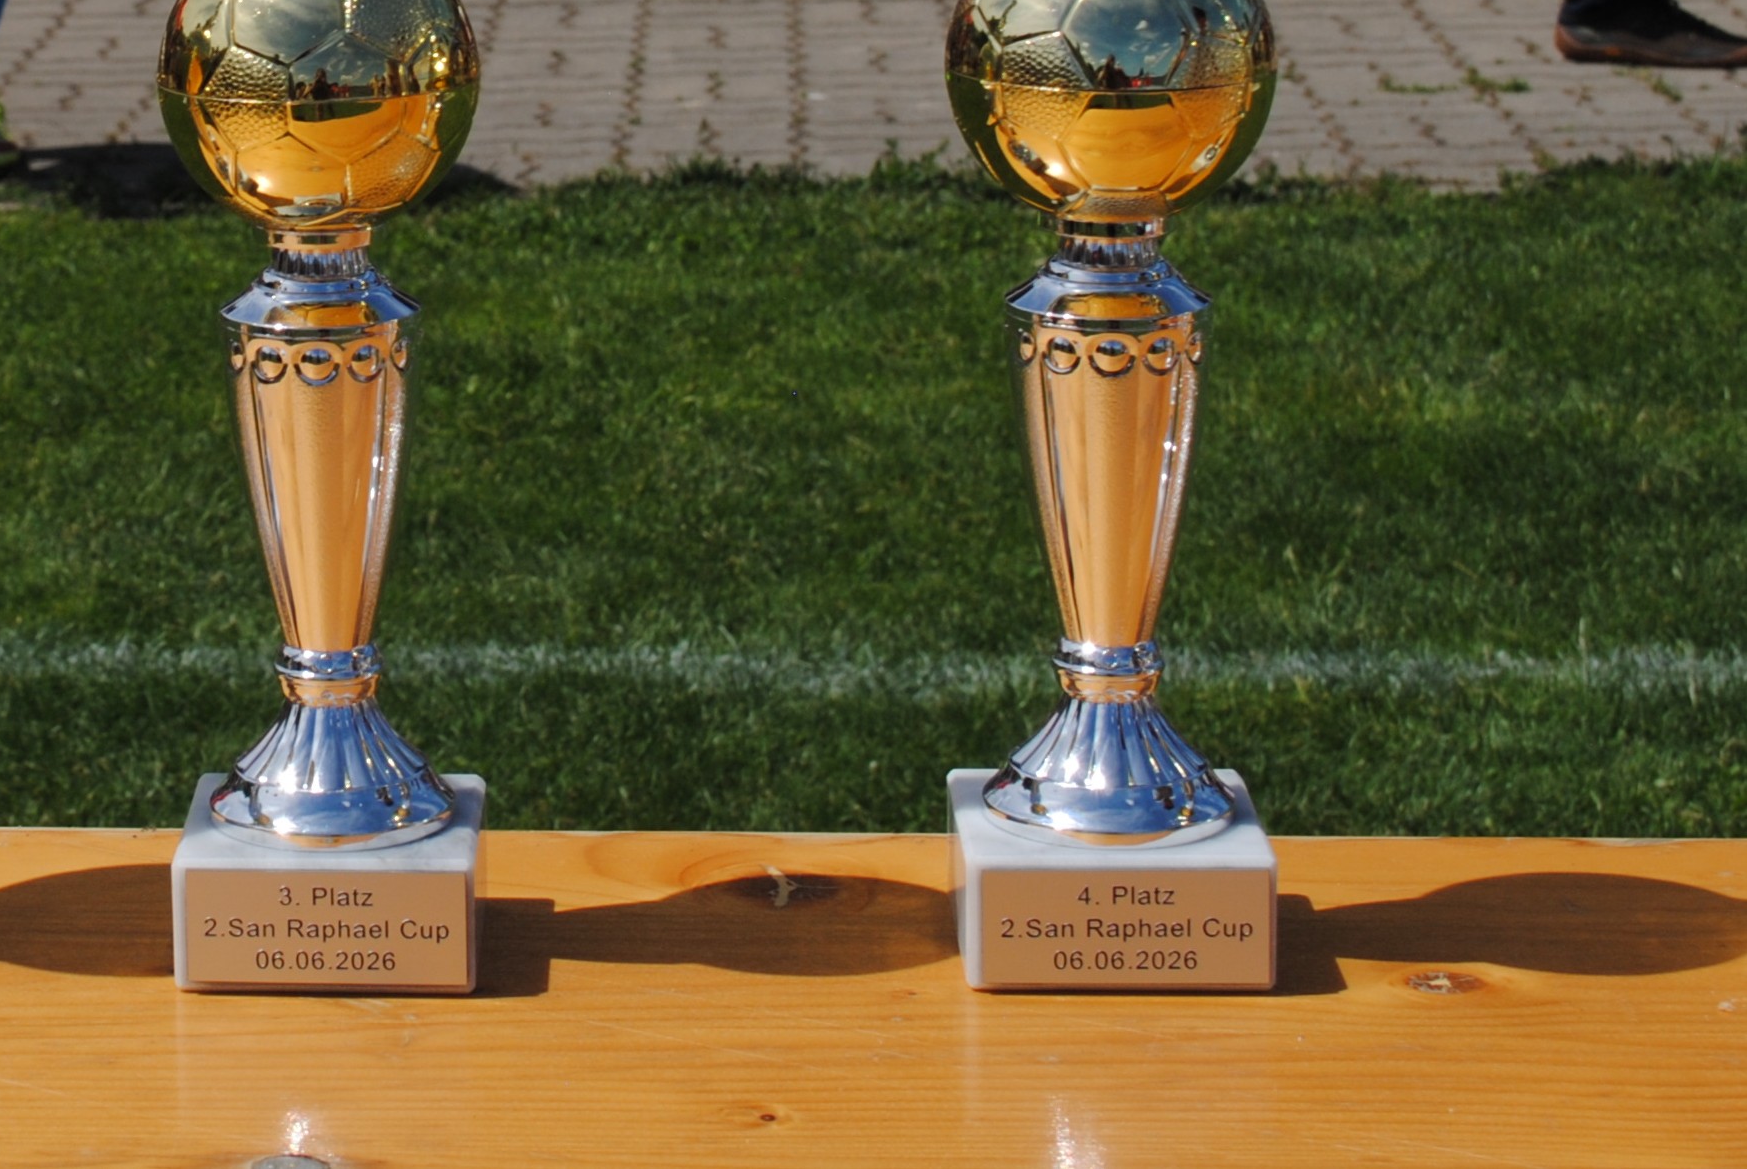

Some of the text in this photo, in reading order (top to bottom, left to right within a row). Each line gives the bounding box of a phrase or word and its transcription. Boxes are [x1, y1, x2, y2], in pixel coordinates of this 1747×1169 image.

[278, 886, 374, 907] 3. Platz
[1076, 885, 1176, 906] 4. Platz
[204, 917, 451, 945] 2.San Raphael Cup
[1000, 917, 1255, 943] 2.San Raphael Cup
[255, 950, 397, 972] 06.06.2026
[1053, 950, 1199, 971] 06.06.2026
